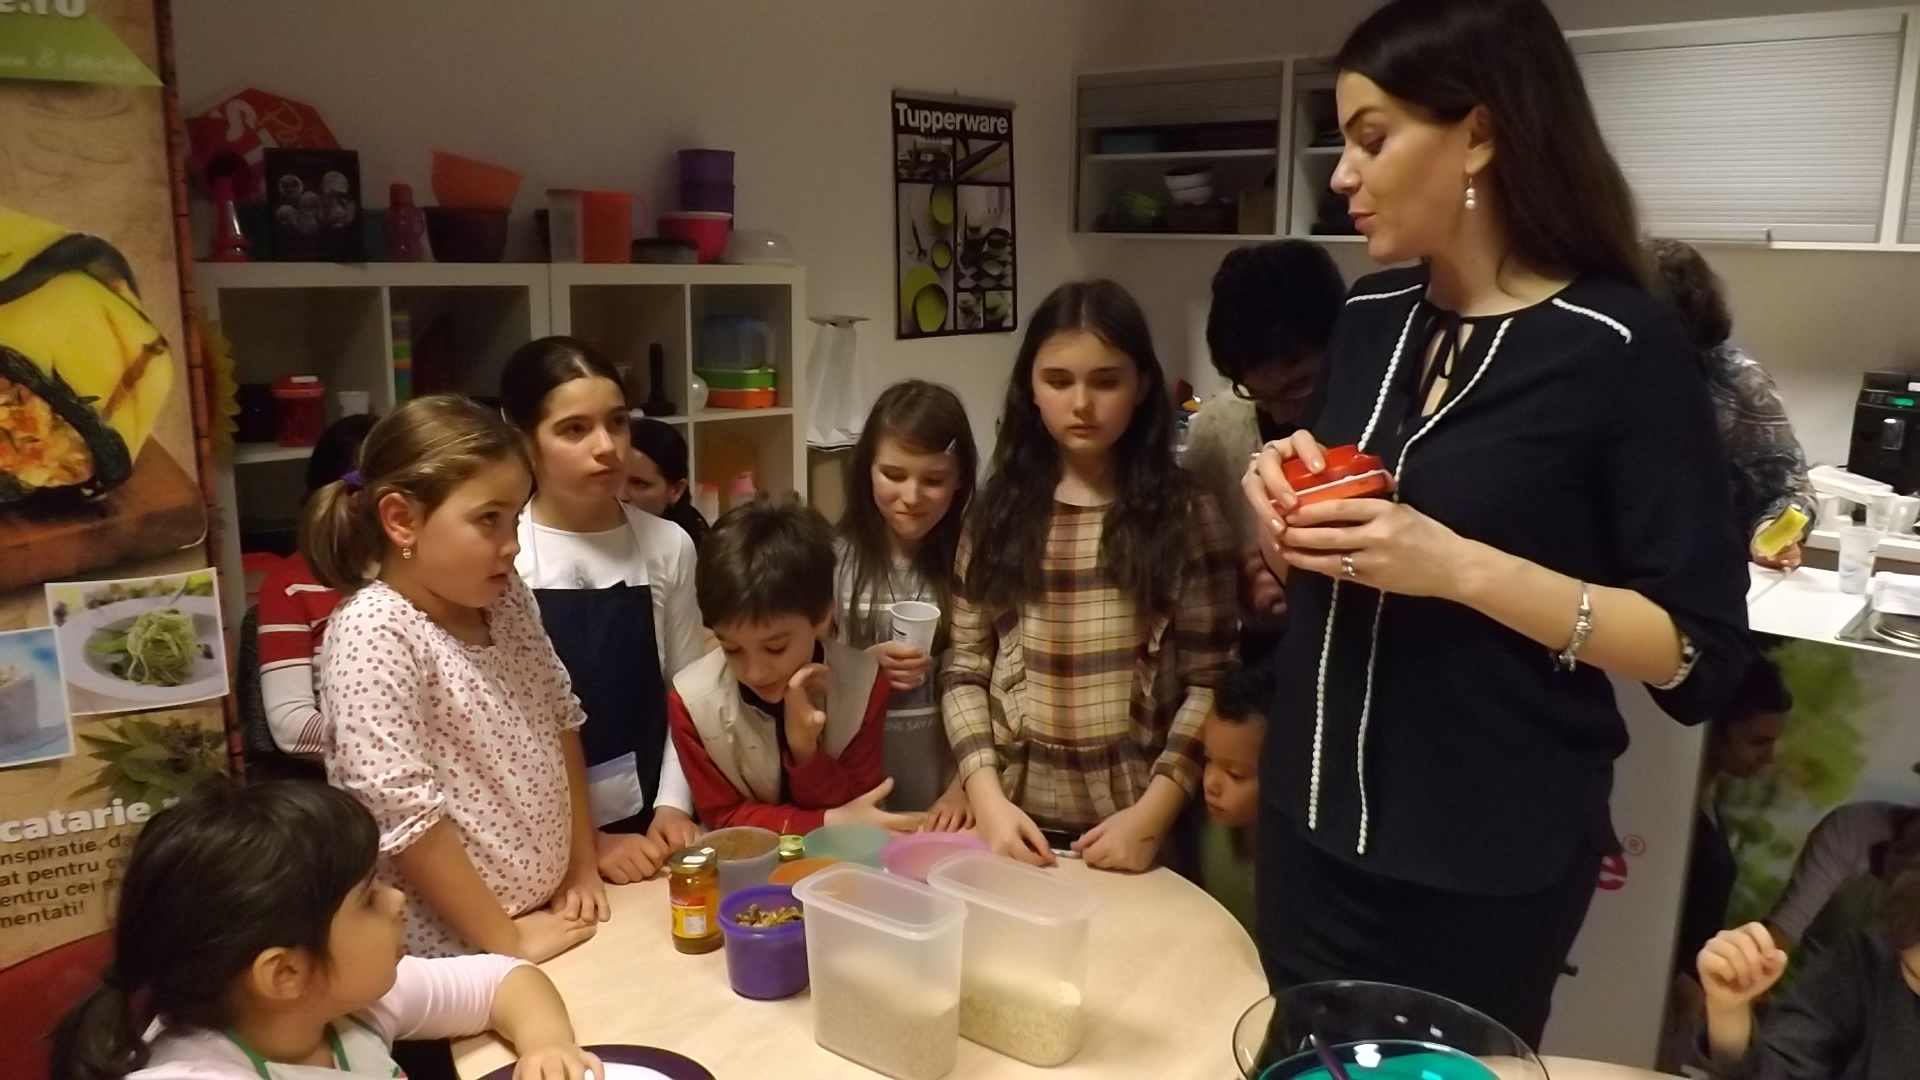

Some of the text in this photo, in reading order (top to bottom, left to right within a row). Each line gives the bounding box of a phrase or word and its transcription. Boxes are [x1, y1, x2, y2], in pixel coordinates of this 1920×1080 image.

[895, 103, 1009, 134] Tupperware
[0, 798, 151, 842] catarie
[0, 871, 20, 887] at
[27, 861, 100, 885] pentru
[0, 888, 59, 907] entru
[65, 878, 96, 897] cei
